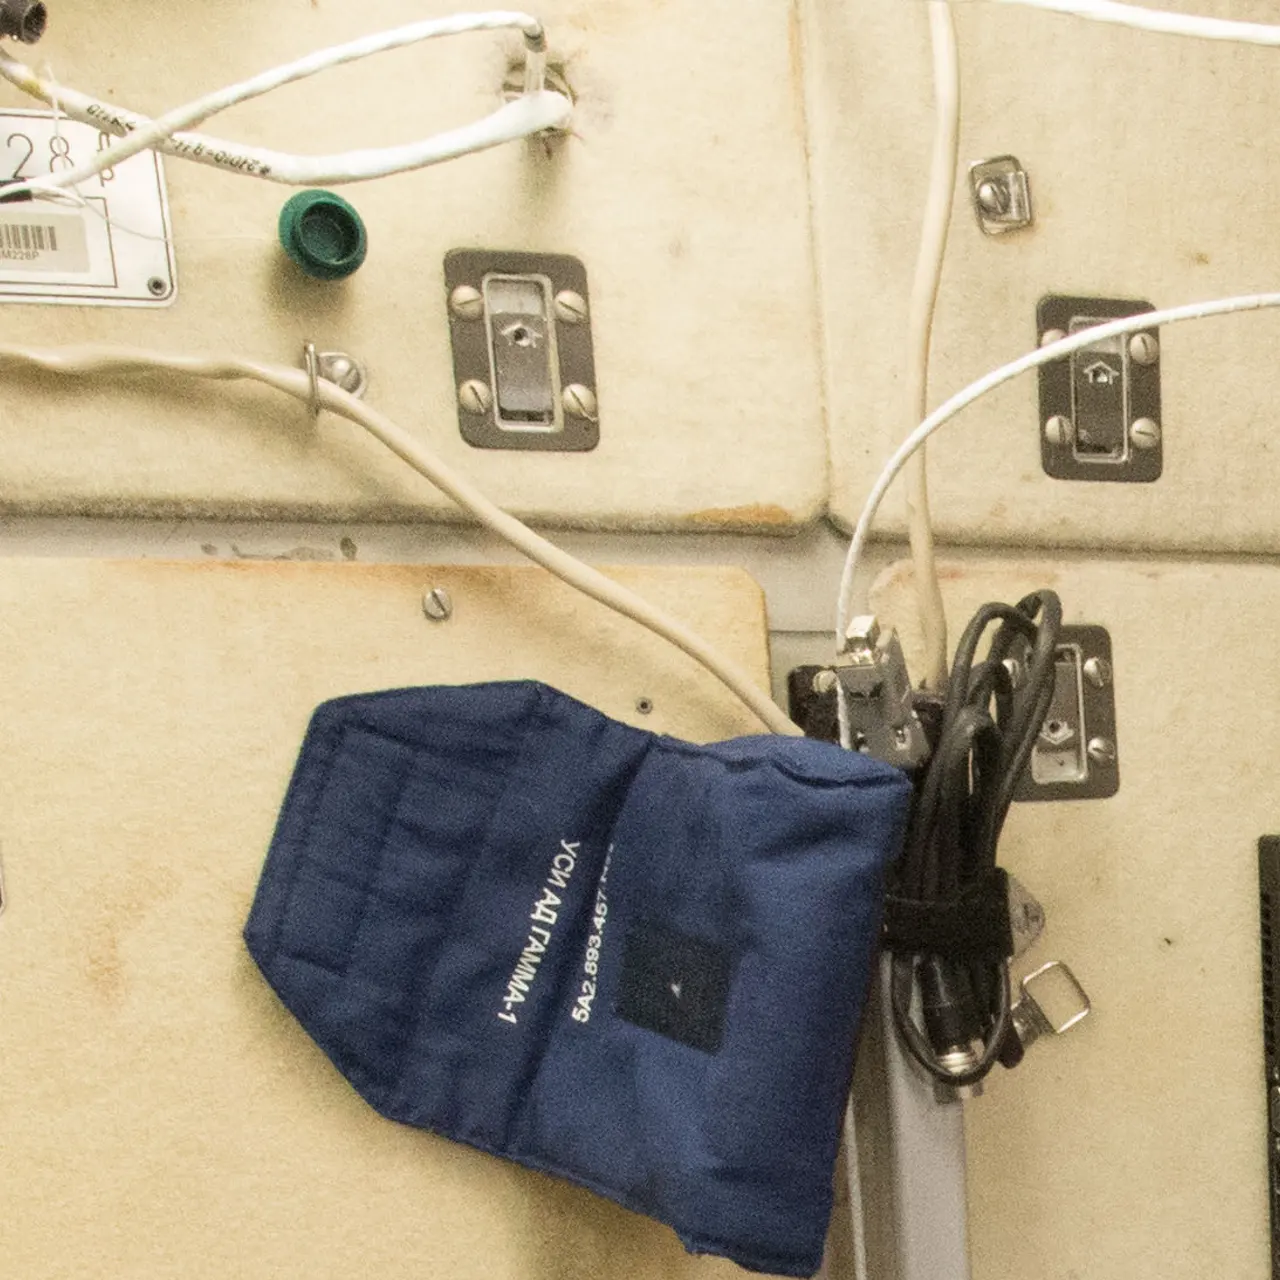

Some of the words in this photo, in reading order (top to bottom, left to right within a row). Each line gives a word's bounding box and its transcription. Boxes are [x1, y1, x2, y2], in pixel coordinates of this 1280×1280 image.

[548, 838, 581, 889] УСИ
[530, 887, 562, 925] АД
[498, 925, 552, 1025] ГАММА-1
